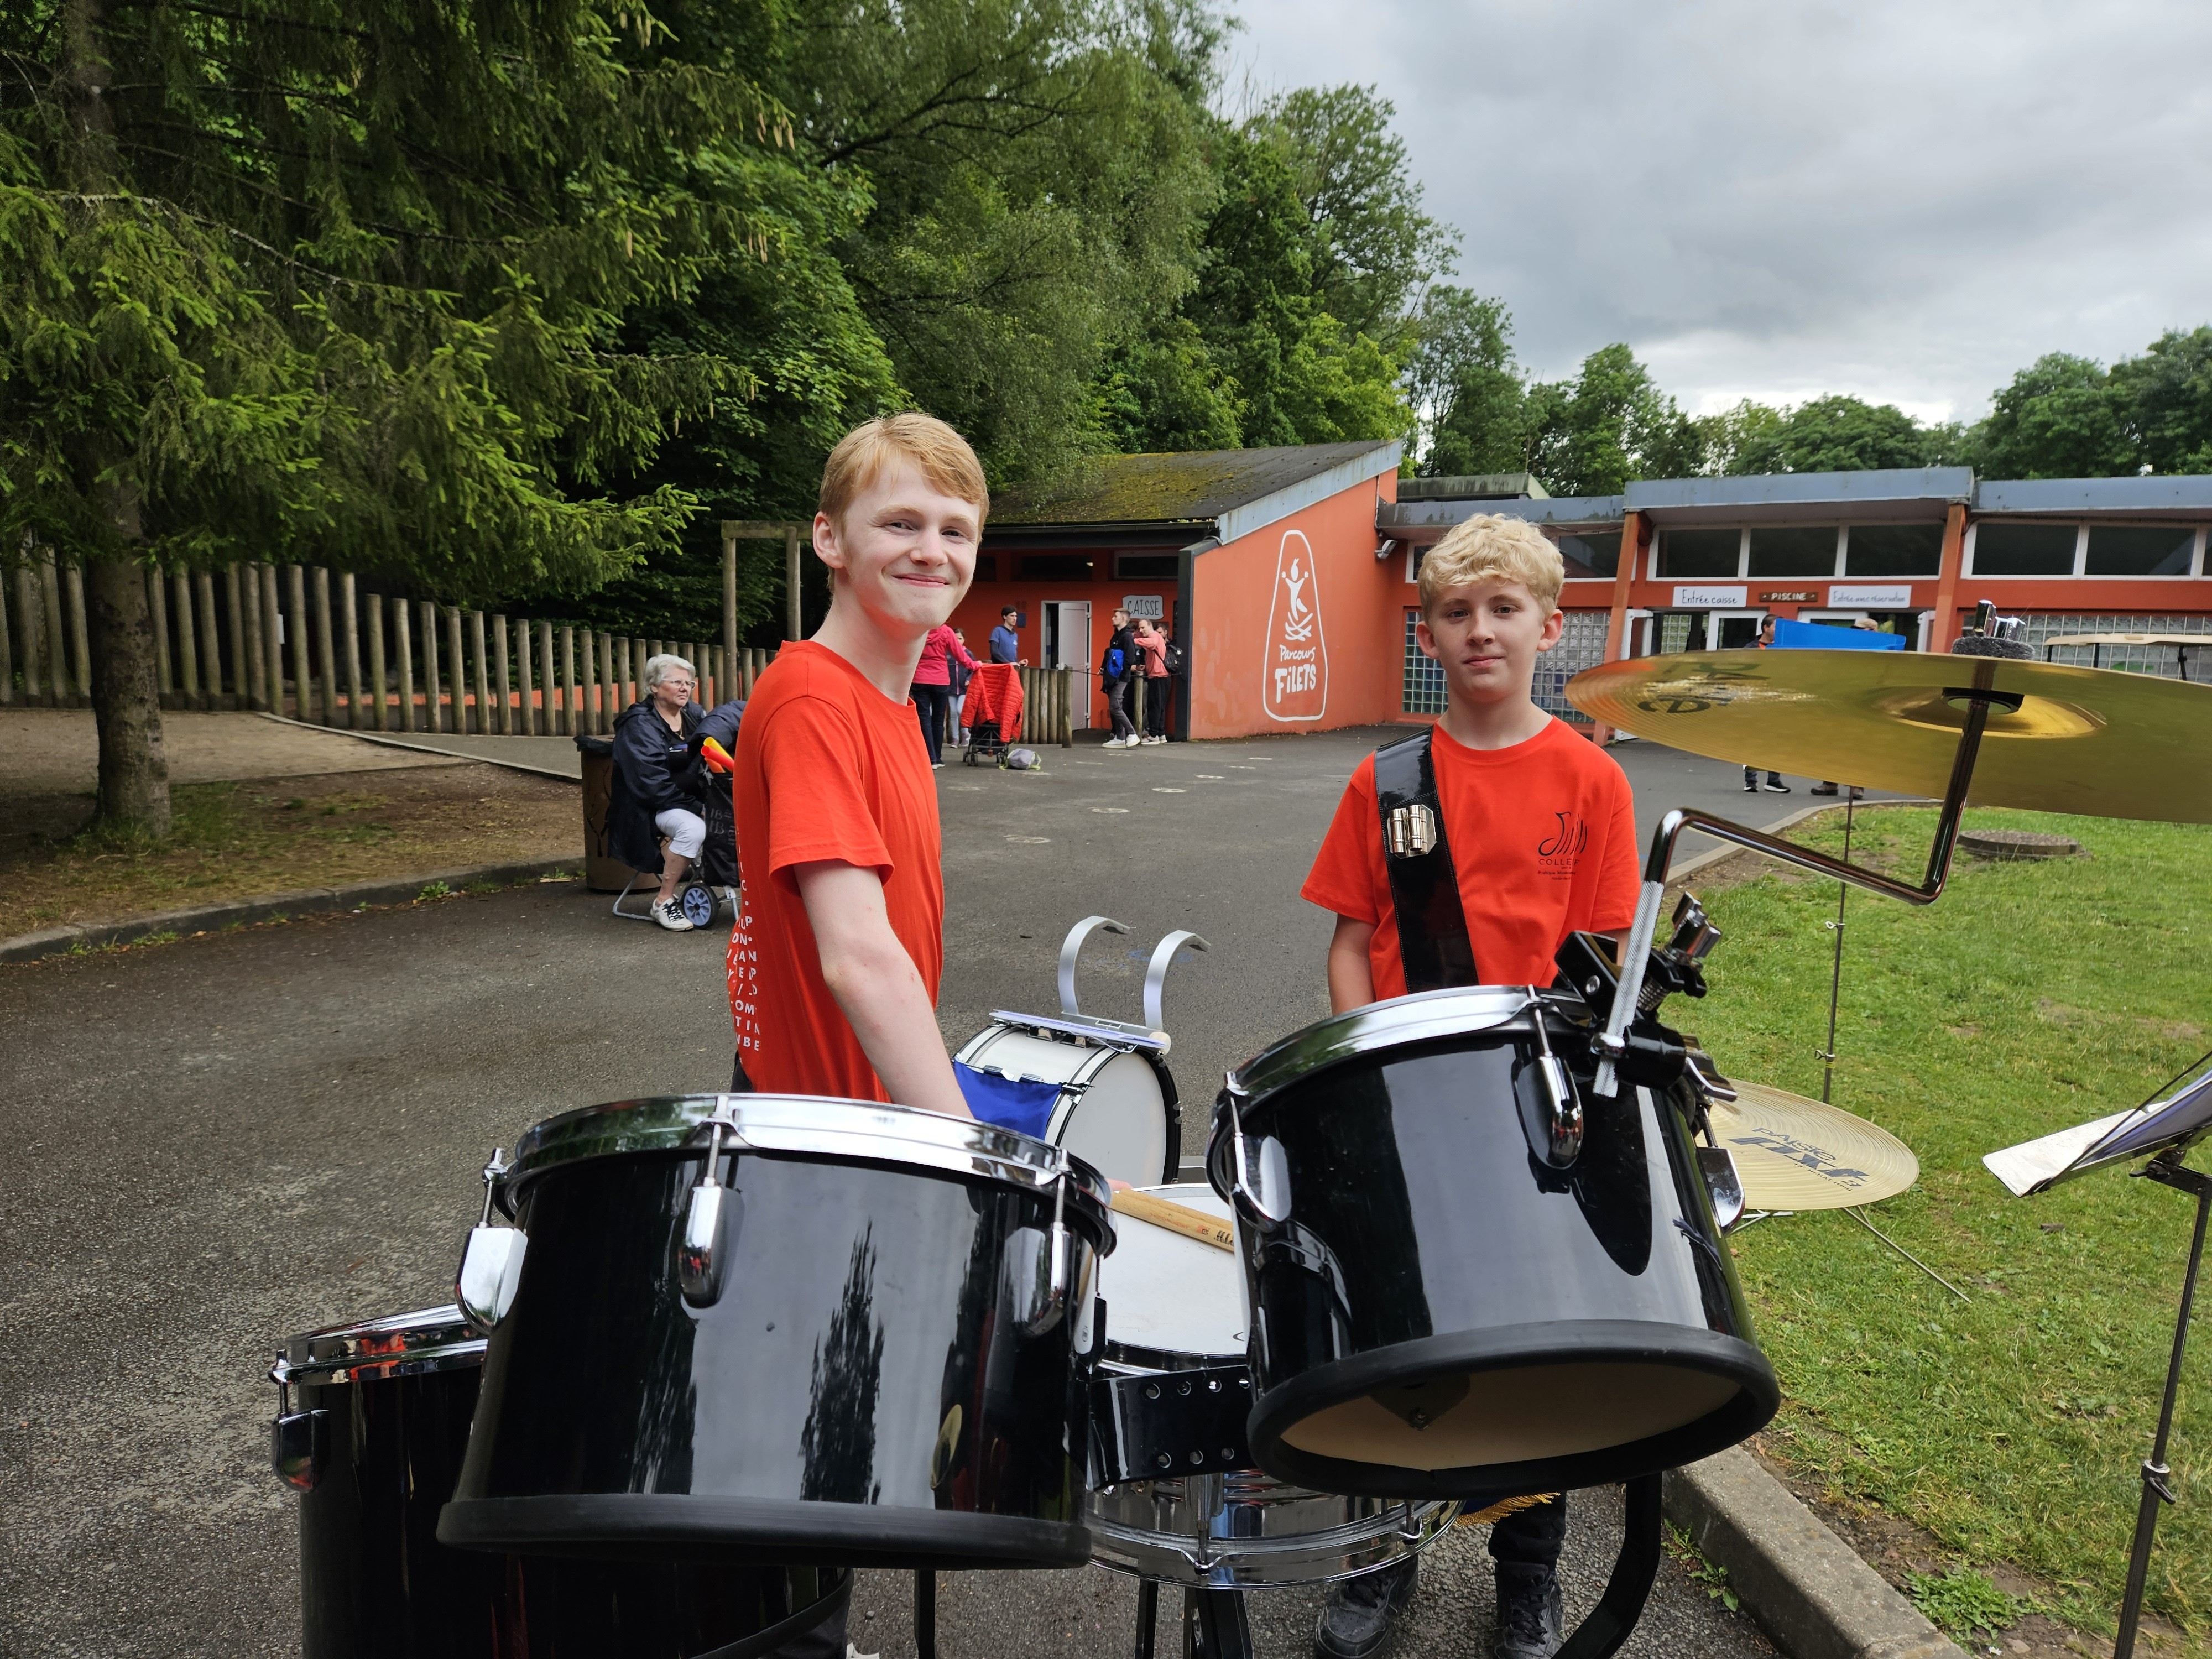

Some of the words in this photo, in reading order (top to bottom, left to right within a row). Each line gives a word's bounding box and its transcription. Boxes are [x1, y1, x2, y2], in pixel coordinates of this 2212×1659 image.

[1682, 589, 1709, 604] Entrée
[1712, 595, 1738, 604] caisse
[1771, 592, 1807, 601] PISCINE
[1128, 599, 1160, 615] CAISSE
[1279, 644, 1316, 662] Parcours
